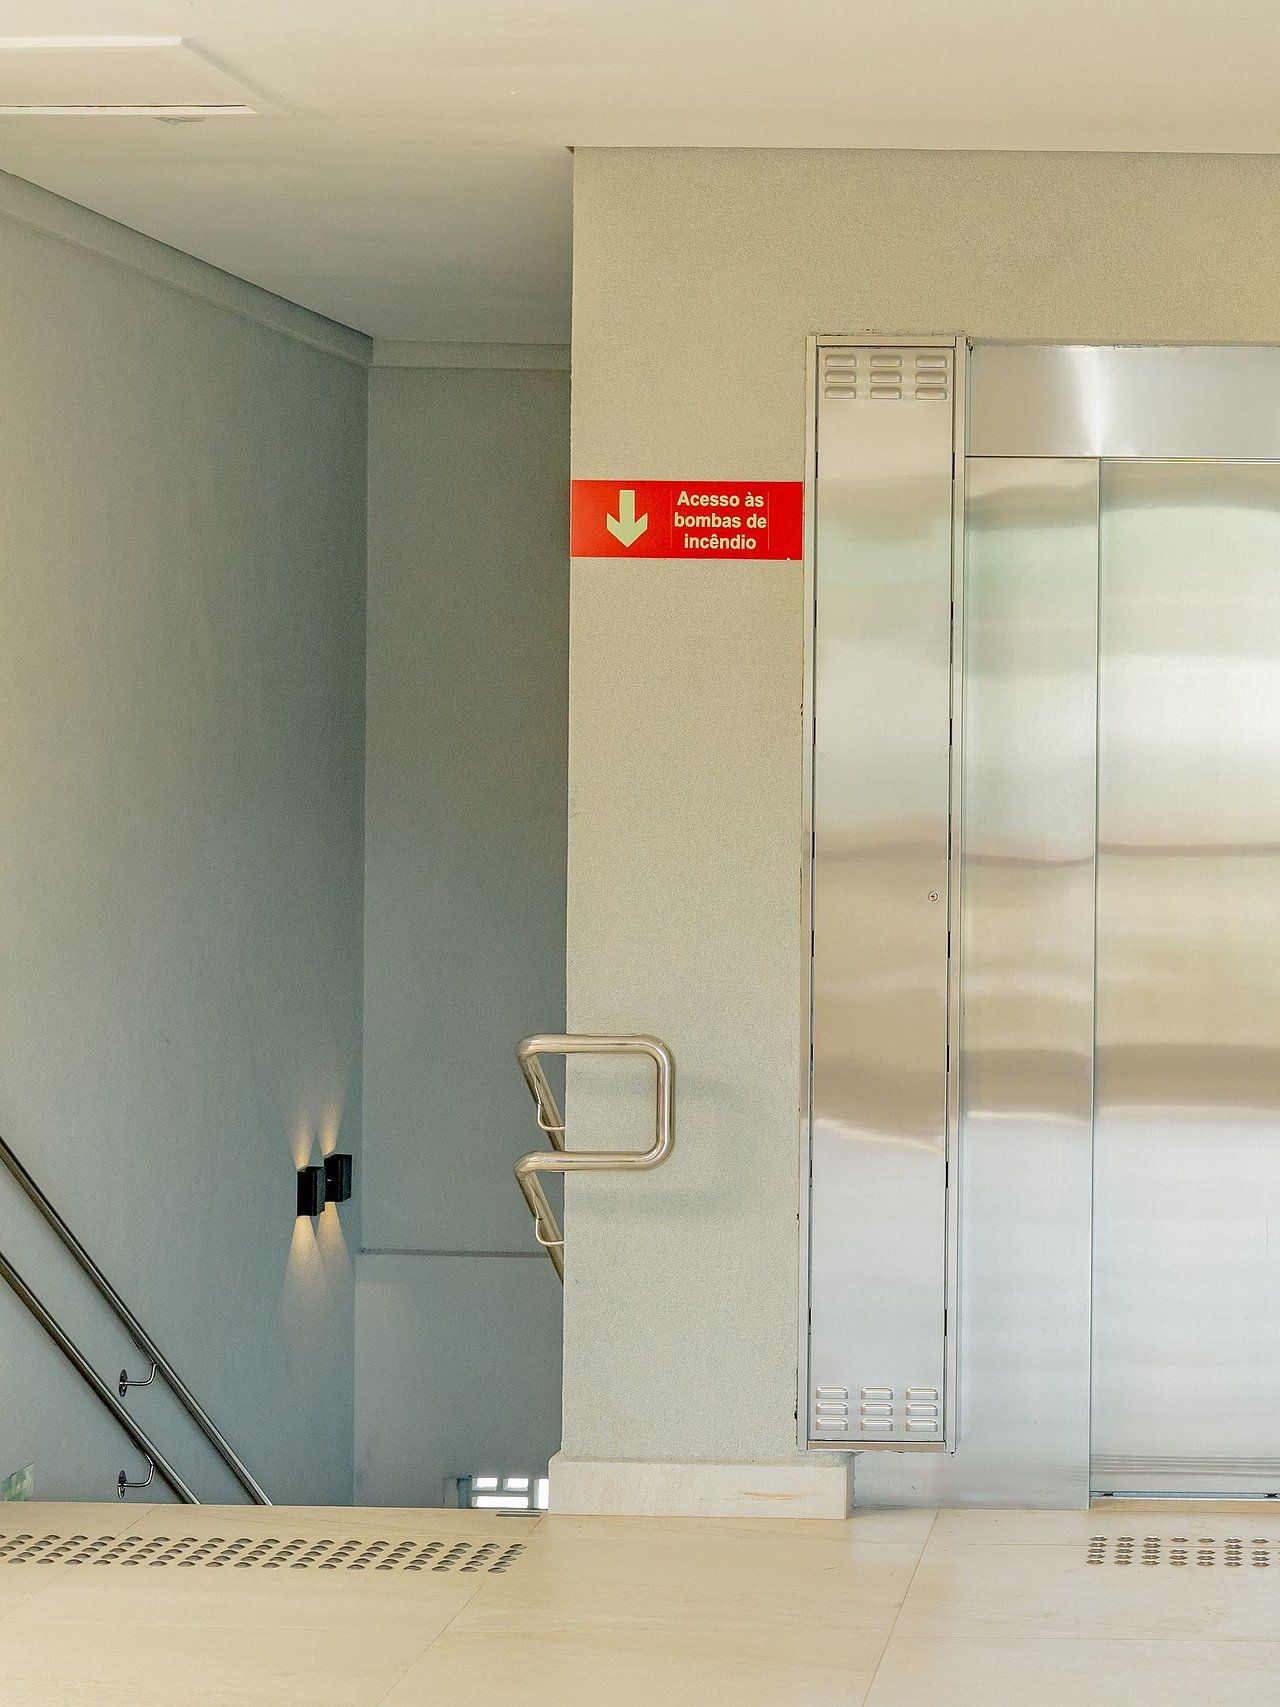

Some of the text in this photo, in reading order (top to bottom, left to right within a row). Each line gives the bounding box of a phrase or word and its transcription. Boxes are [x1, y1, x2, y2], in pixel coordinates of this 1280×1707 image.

[676, 490, 764, 508] Acesso às
[674, 511, 767, 529] bombas de
[684, 533, 757, 550] incêndio
